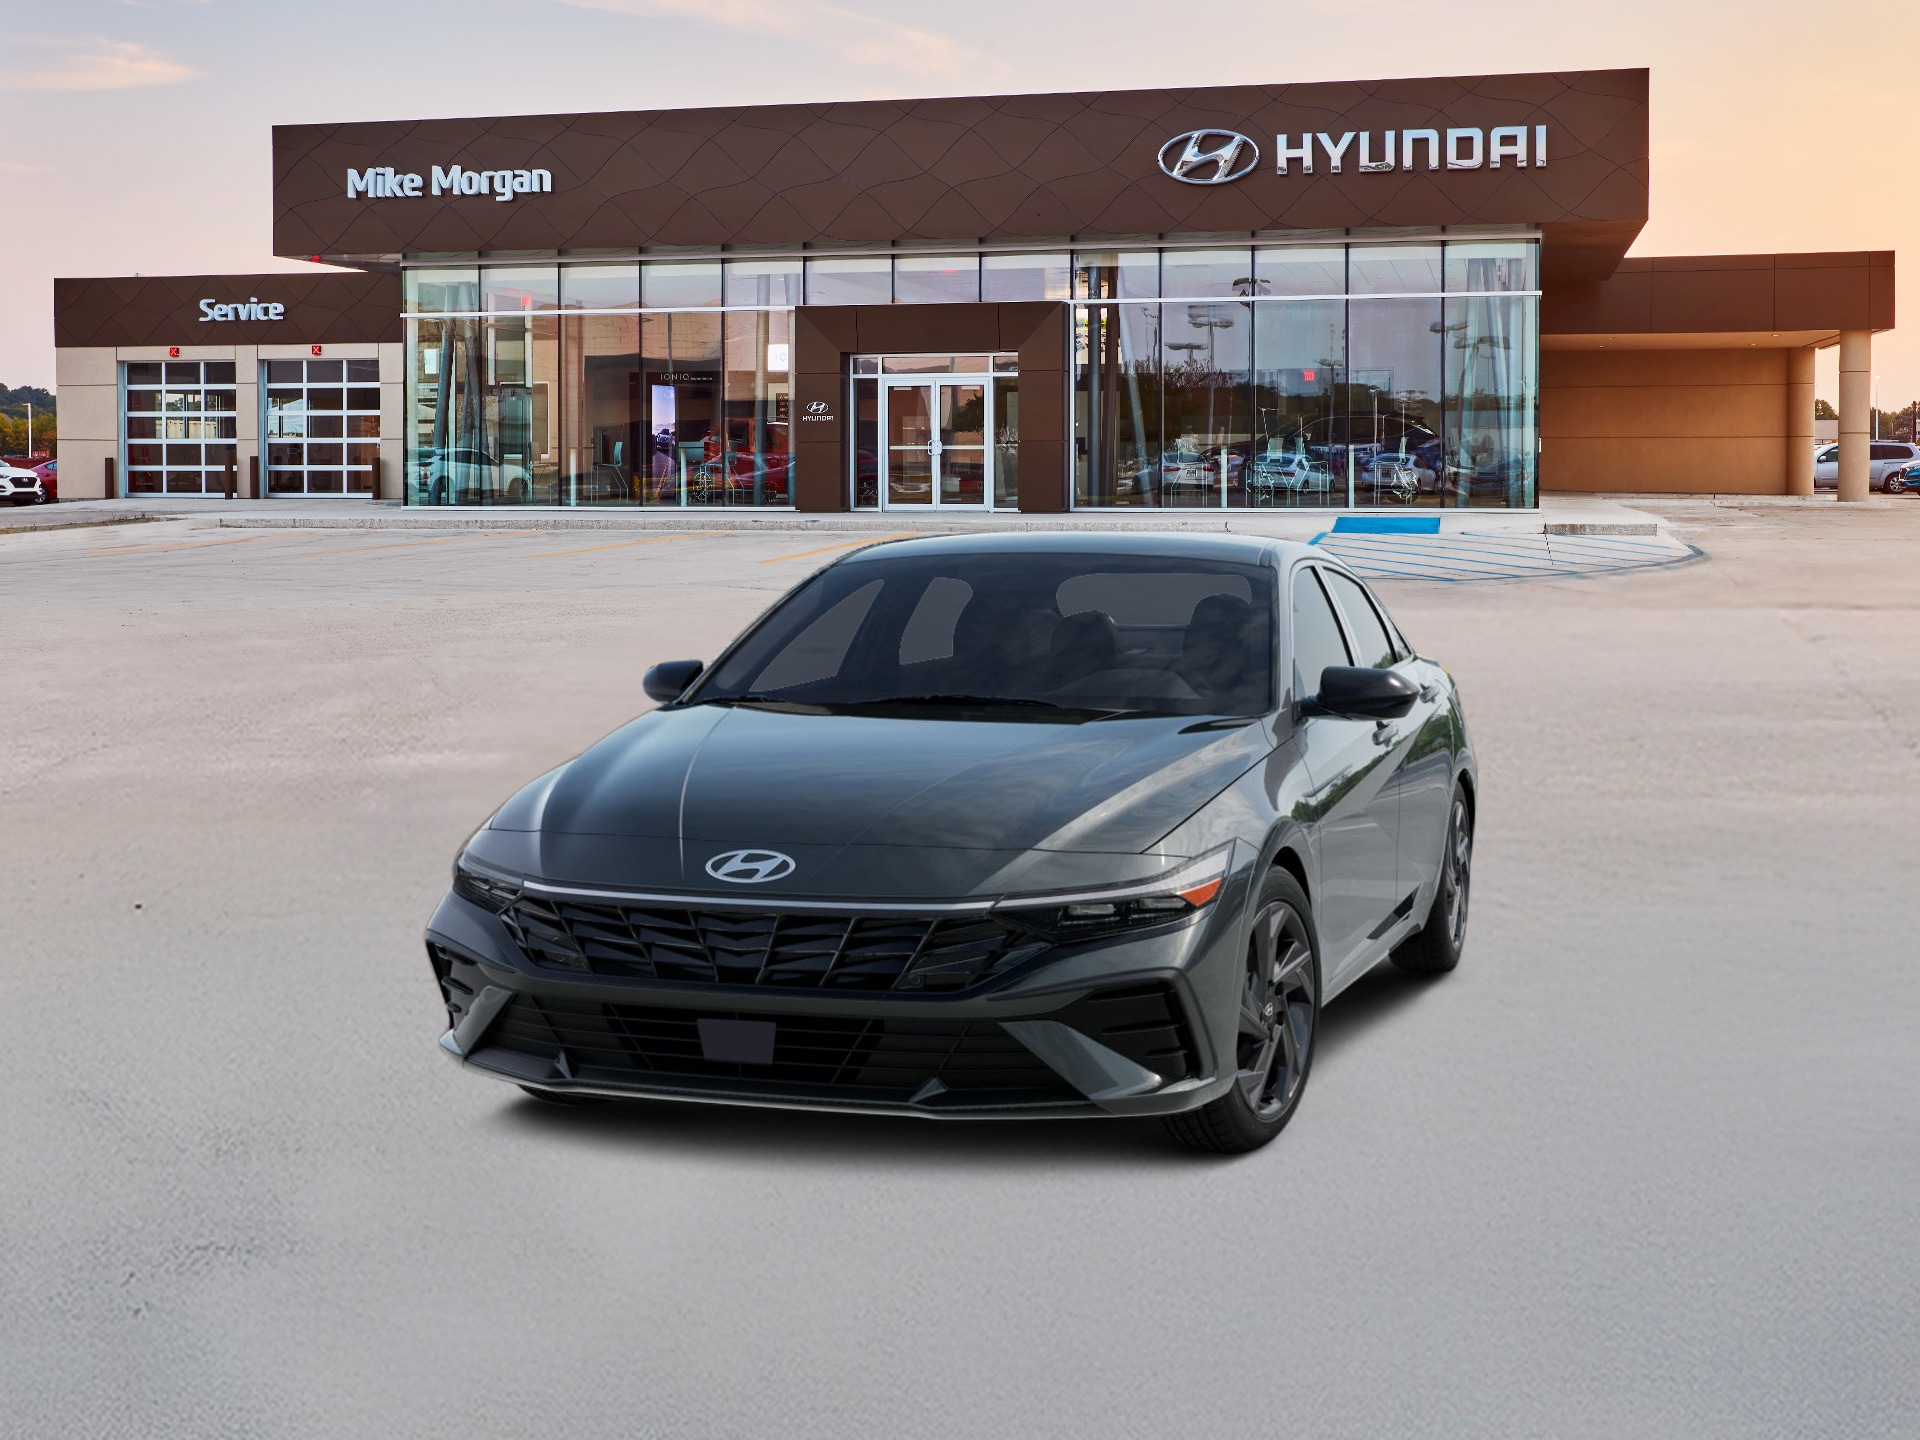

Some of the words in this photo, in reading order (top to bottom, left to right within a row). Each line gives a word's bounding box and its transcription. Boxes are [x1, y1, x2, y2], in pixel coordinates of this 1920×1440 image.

[1276, 124, 1548, 175] HYUNDAI
[346, 167, 424, 199] Mike
[431, 164, 552, 202] Morgan
[198, 296, 285, 322] Service
